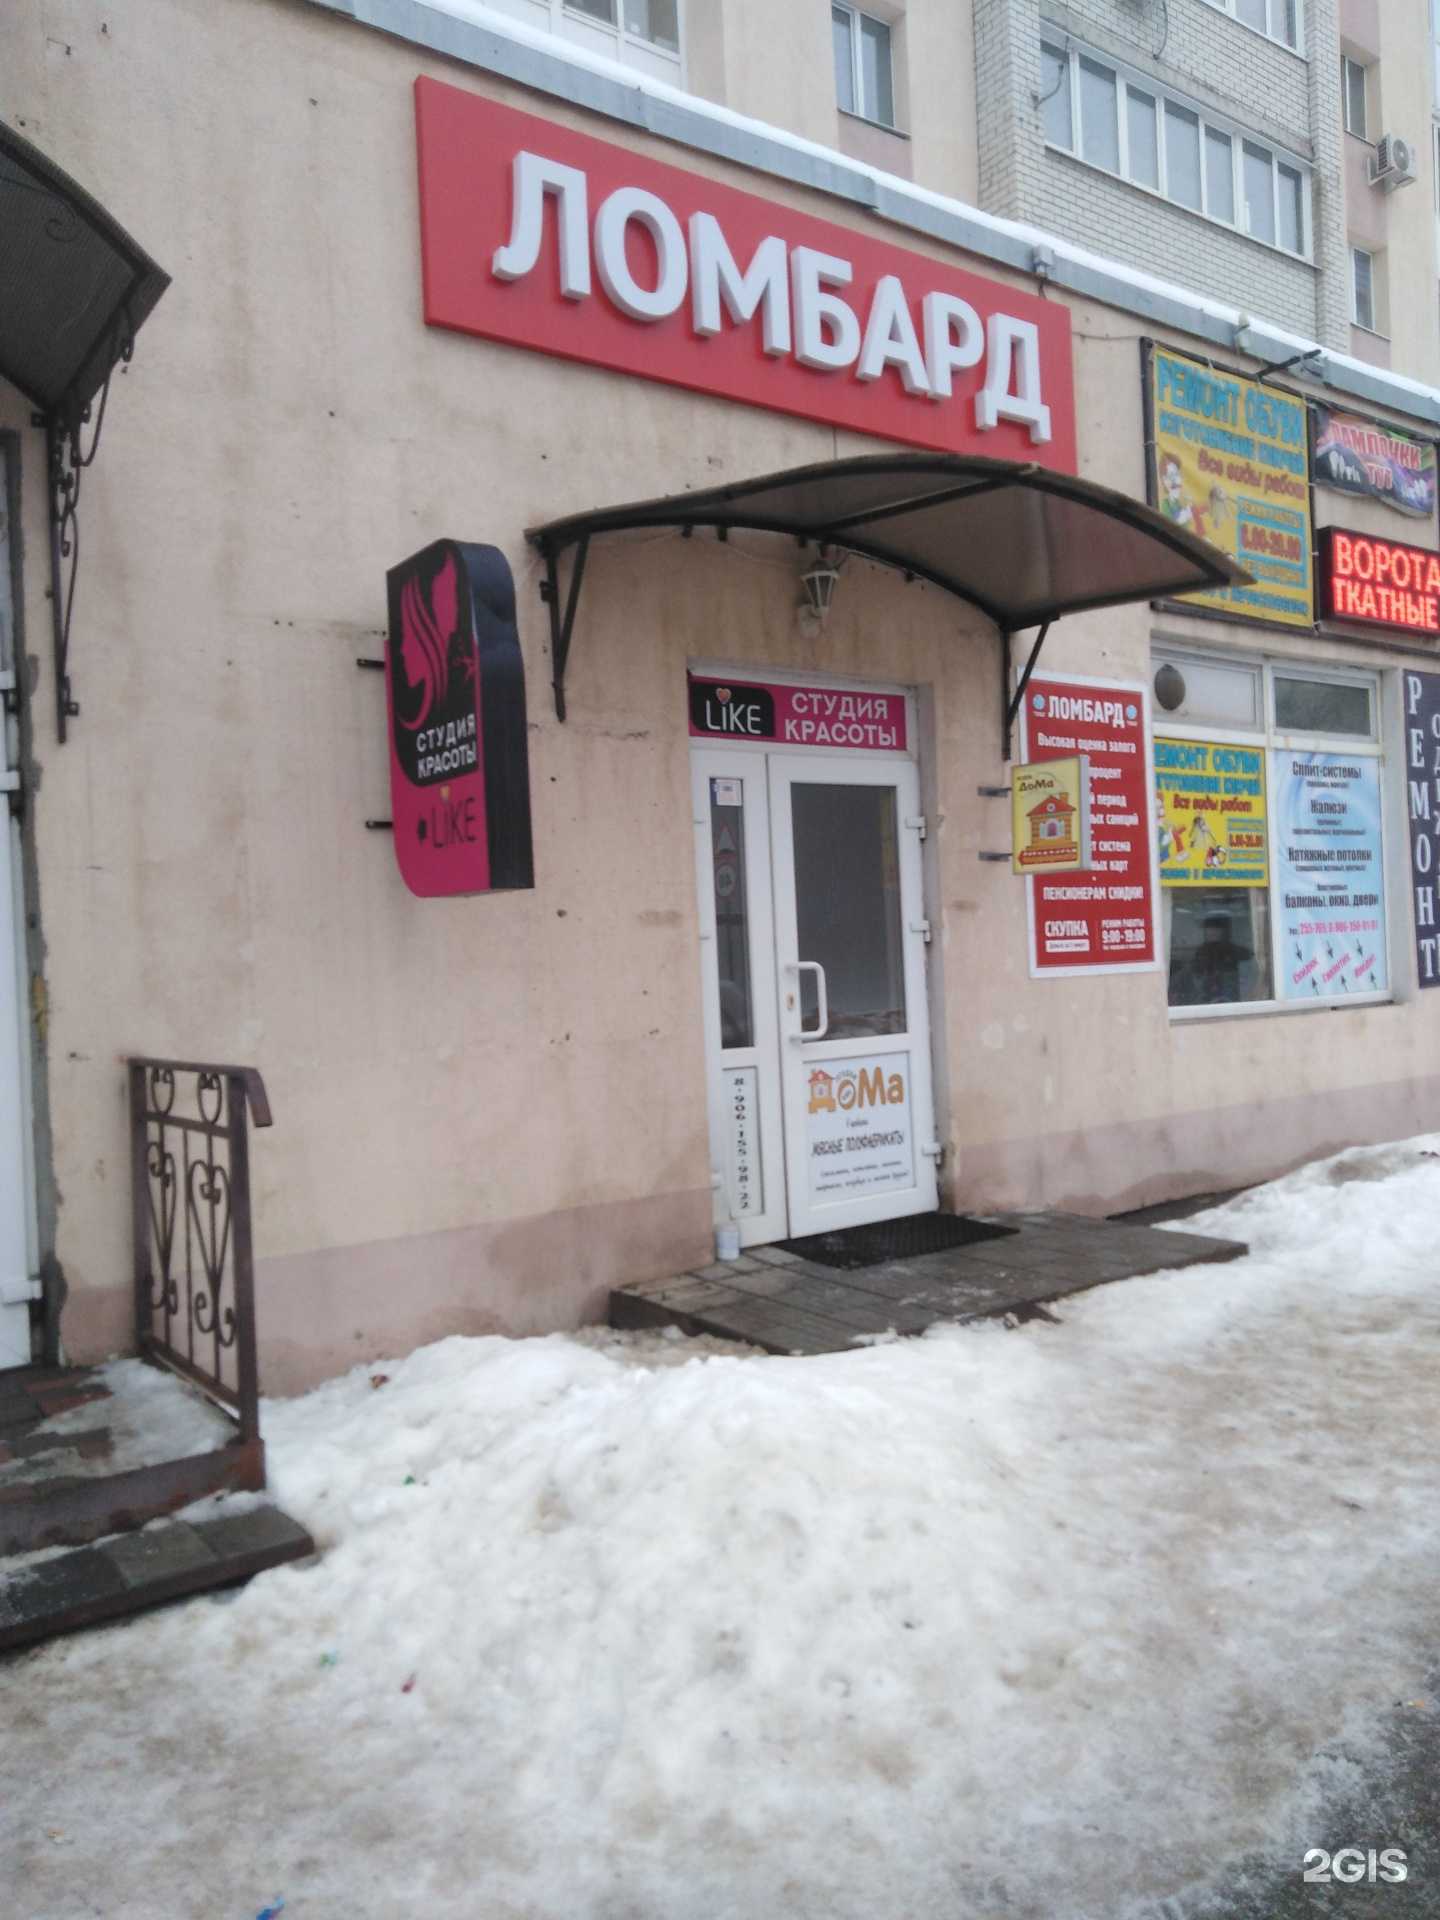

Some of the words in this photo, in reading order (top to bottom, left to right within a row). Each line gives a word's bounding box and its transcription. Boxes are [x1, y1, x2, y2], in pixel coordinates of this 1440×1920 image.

[491, 150, 1052, 445] ЛОМБАРД
[1157, 356, 1241, 427] РЕМОНТ
[1246, 386, 1306, 449] ОБУВИ
[1334, 534, 1440, 595] ВОРОТА
[1333, 577, 1439, 629] ТКАТНЫЕ
[791, 692, 888, 721] СТУДИЯ
[1048, 695, 1126, 728] ЛОМБАРД
[416, 713, 476, 753] СТУДИЯ
[784, 718, 897, 746] КРАСОТЫ
[417, 741, 476, 779] КРАСОТЫ
[1292, 760, 1362, 779] Сплит-системы
[1311, 799, 1347, 815] Жалюзи
[1288, 847, 1336, 862] Натяжные
[1043, 887, 1106, 900] ПЕНСИОНЕРАМ
[1044, 920, 1089, 937] СКУПКА
